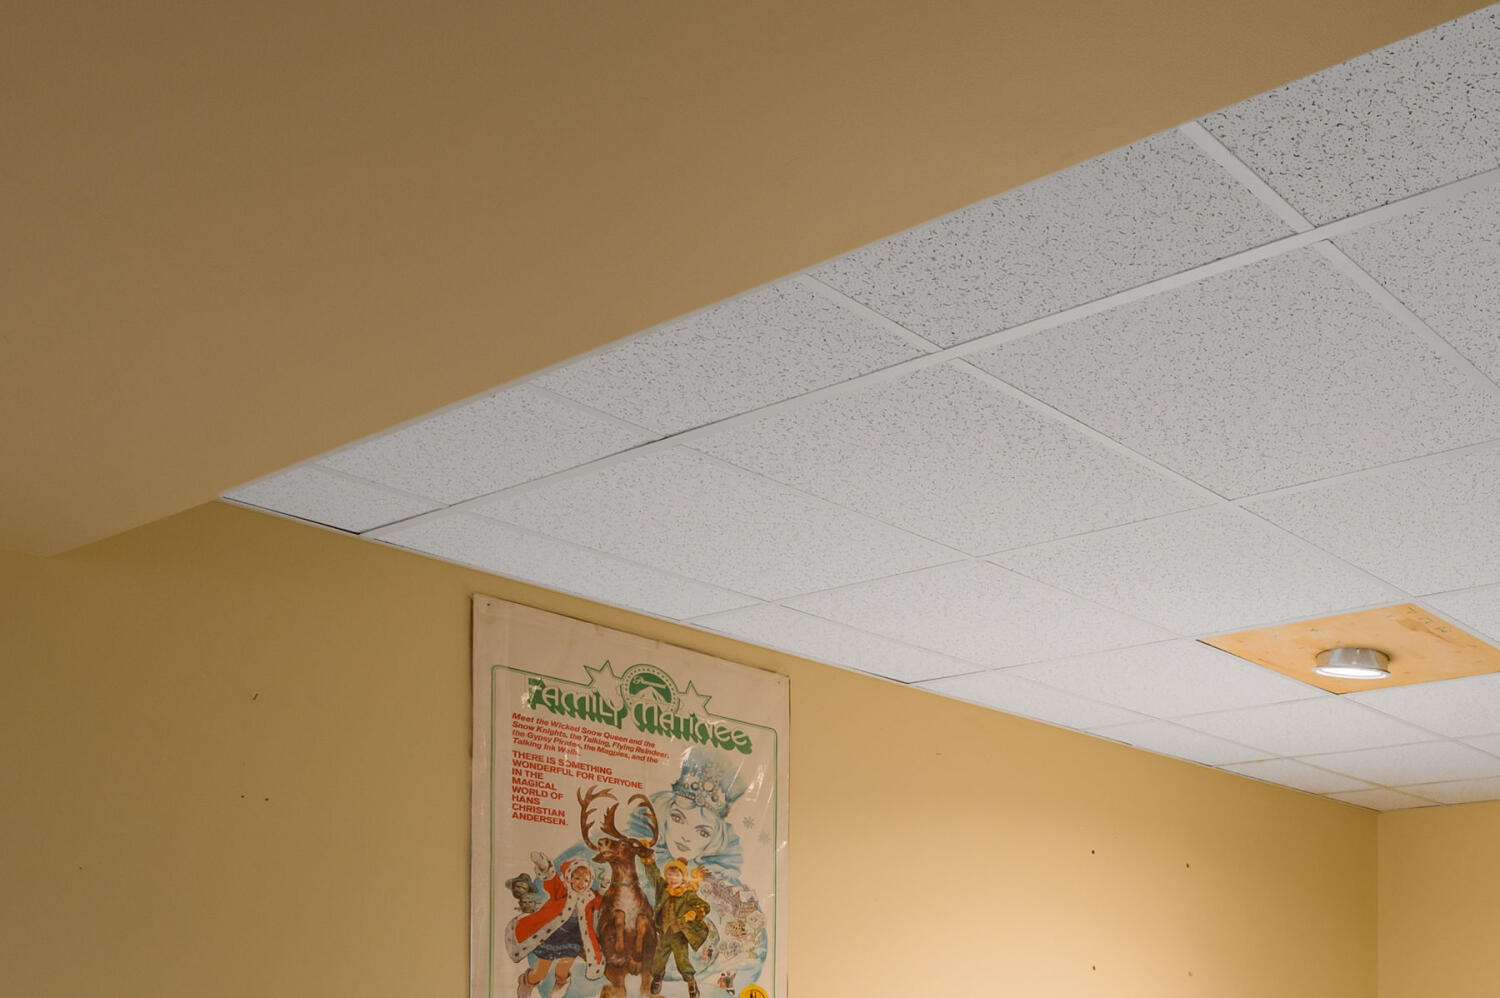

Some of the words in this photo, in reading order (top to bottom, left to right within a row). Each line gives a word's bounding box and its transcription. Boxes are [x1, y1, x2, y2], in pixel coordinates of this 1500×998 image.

[512, 712, 534, 722] Meet
[551, 721, 580, 732] Wicked
[581, 727, 602, 736] Snow
[604, 732, 627, 743] Queen
[512, 721, 534, 730] Snow
[613, 742, 634, 752] Flying
[528, 732, 552, 743] Gypsy
[513, 738, 542, 750] Talking
[512, 750, 544, 762] THERE
[547, 756, 555, 764] IS
[559, 758, 612, 775] SOMETHING
[512, 768, 522, 776] IN
[525, 770, 544, 779] THE
[512, 759, 573, 777] WONDERFUL
[576, 770, 594, 780] FOR
[597, 775, 644, 789] EVERYONE
[512, 777, 557, 791] MAGICAL
[512, 786, 548, 798] WORLD
[550, 792, 563, 800] OF
[512, 794, 540, 805] HANS
[512, 803, 565, 817] CHRISTIAN
[512, 812, 568, 826] ANDERSEN.
